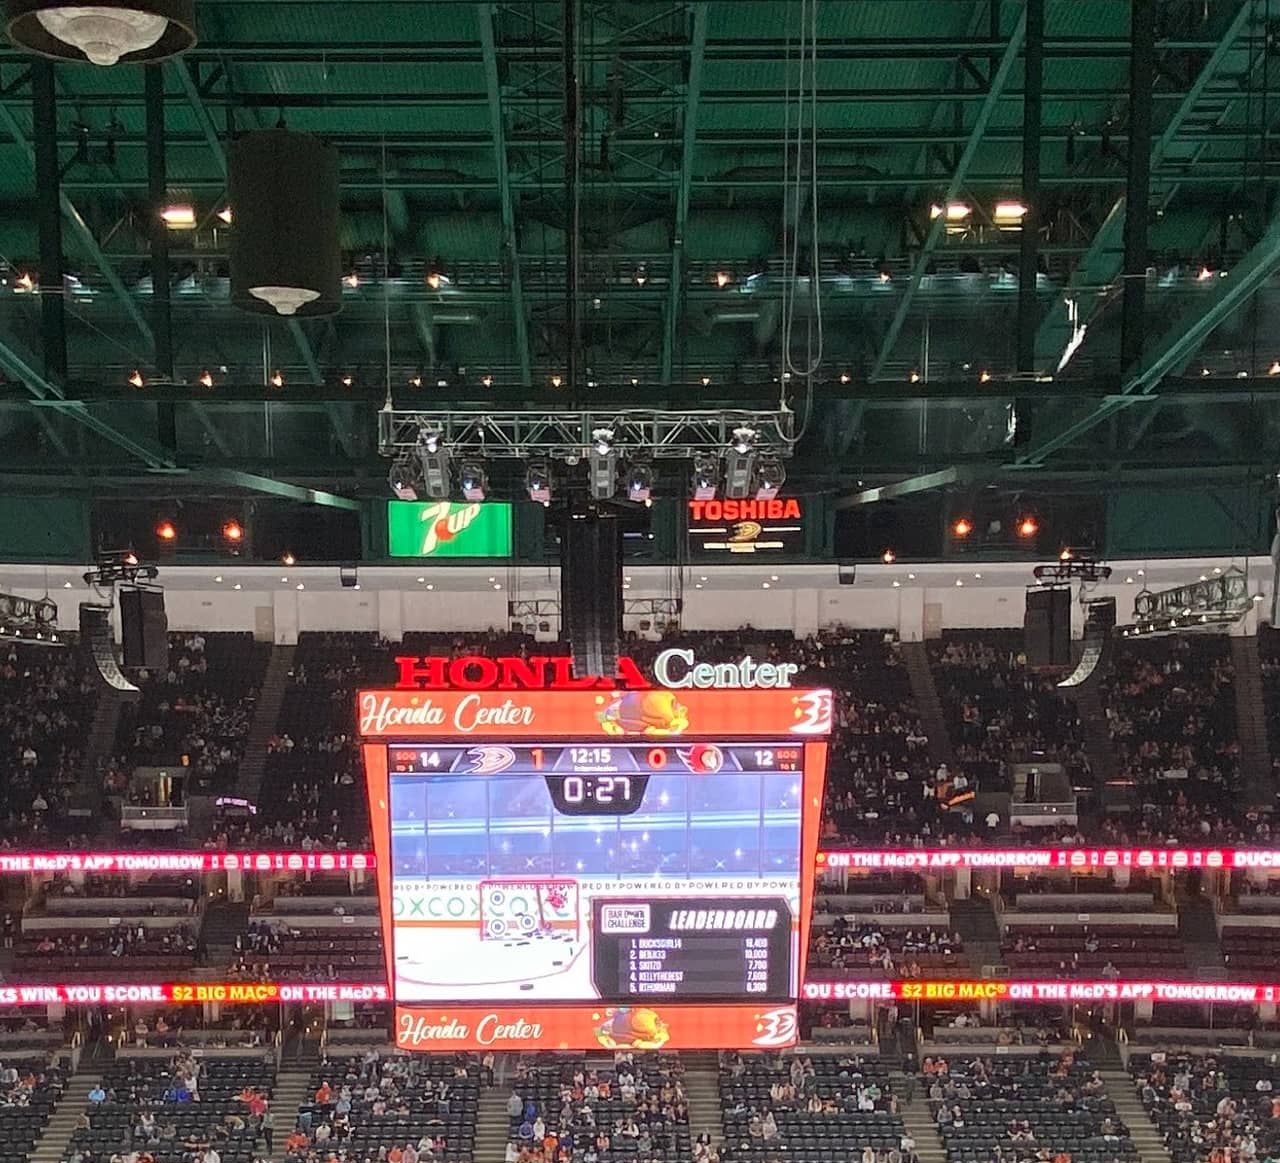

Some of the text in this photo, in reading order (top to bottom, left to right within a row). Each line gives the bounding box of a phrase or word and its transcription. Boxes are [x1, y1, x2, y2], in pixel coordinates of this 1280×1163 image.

[690, 500, 800, 519] TOSHIBA
[654, 649, 798, 689] Center
[361, 694, 536, 731] Honda Center
[421, 752, 440, 767] 14
[570, 749, 611, 763] 12:15
[755, 751, 773, 765] 12
[565, 777, 631, 802] 0:27
[0, 857, 31, 869] THE
[34, 856, 82, 868] McD'S
[84, 856, 113, 868] APP
[116, 856, 203, 868] TOMORROW
[828, 854, 1051, 866] ON THE McD'S APP TOMORROW
[670, 910, 778, 929] LEADERBOARD
[21, 988, 62, 1001] WIN.
[65, 986, 100, 1000] YOU
[104, 986, 167, 1000] SCORE.
[197, 986, 226, 999] BIG
[280, 986, 302, 999] ON
[305, 986, 336, 999] THE
[834, 985, 895, 998] SCORE.
[926, 985, 956, 997] BIG
[1010, 986, 1033, 998] ON
[1036, 986, 1068, 998] THE
[1071, 986, 1117, 998] McD'S
[1120, 986, 1153, 998] APP
[1157, 986, 1256, 1000] TOMORROW
[398, 1014, 543, 1044] Honda Center
